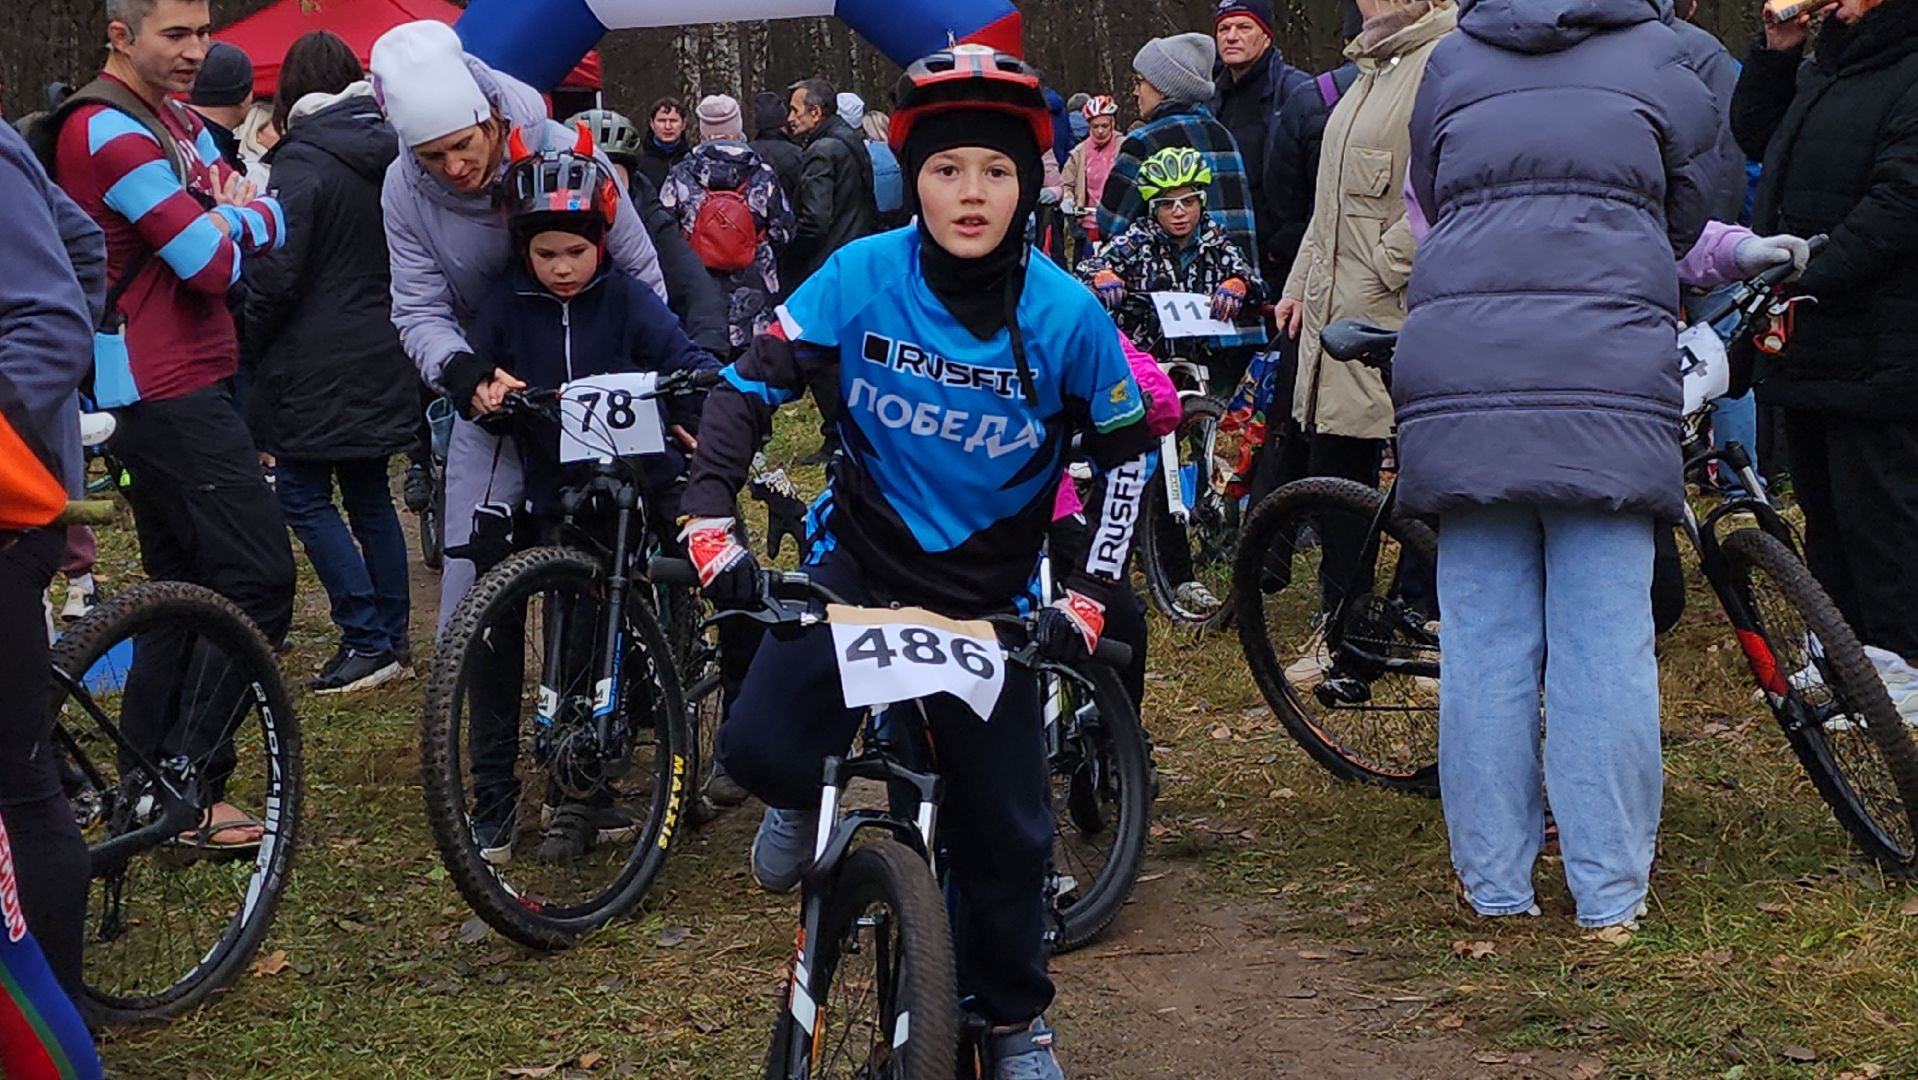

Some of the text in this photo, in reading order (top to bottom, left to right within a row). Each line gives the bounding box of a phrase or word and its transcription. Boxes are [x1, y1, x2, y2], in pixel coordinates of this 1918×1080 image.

[1163, 301, 1210, 321] 11
[577, 389, 636, 432] 78
[848, 378, 1040, 459] ПОБЕДА
[845, 627, 995, 680] 486
[657, 753, 685, 850] MAXXIS
